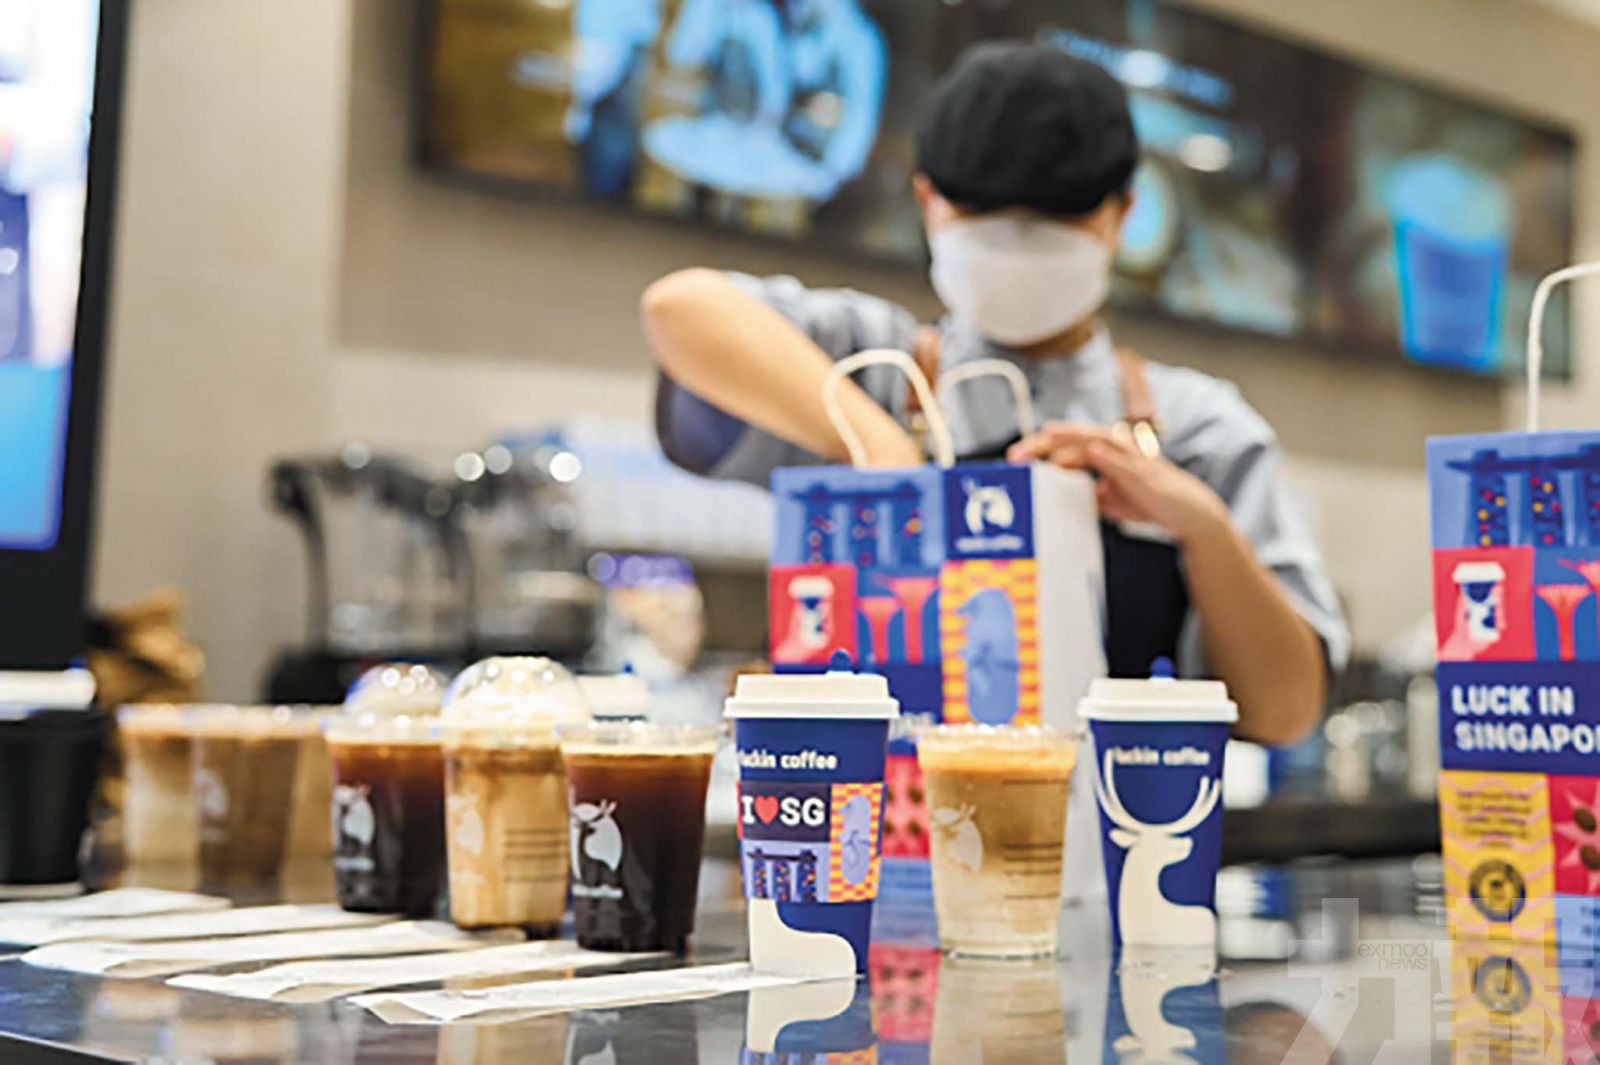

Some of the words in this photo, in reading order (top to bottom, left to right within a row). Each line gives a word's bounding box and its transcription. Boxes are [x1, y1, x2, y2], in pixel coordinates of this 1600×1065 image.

[1452, 685, 1531, 715] LUCK
[1538, 686, 1574, 715] IN
[1454, 721, 1600, 753] SINGAPO
[780, 749, 837, 769] coffee
[1115, 745, 1159, 765] luckin
[1162, 746, 1210, 766] coffee
